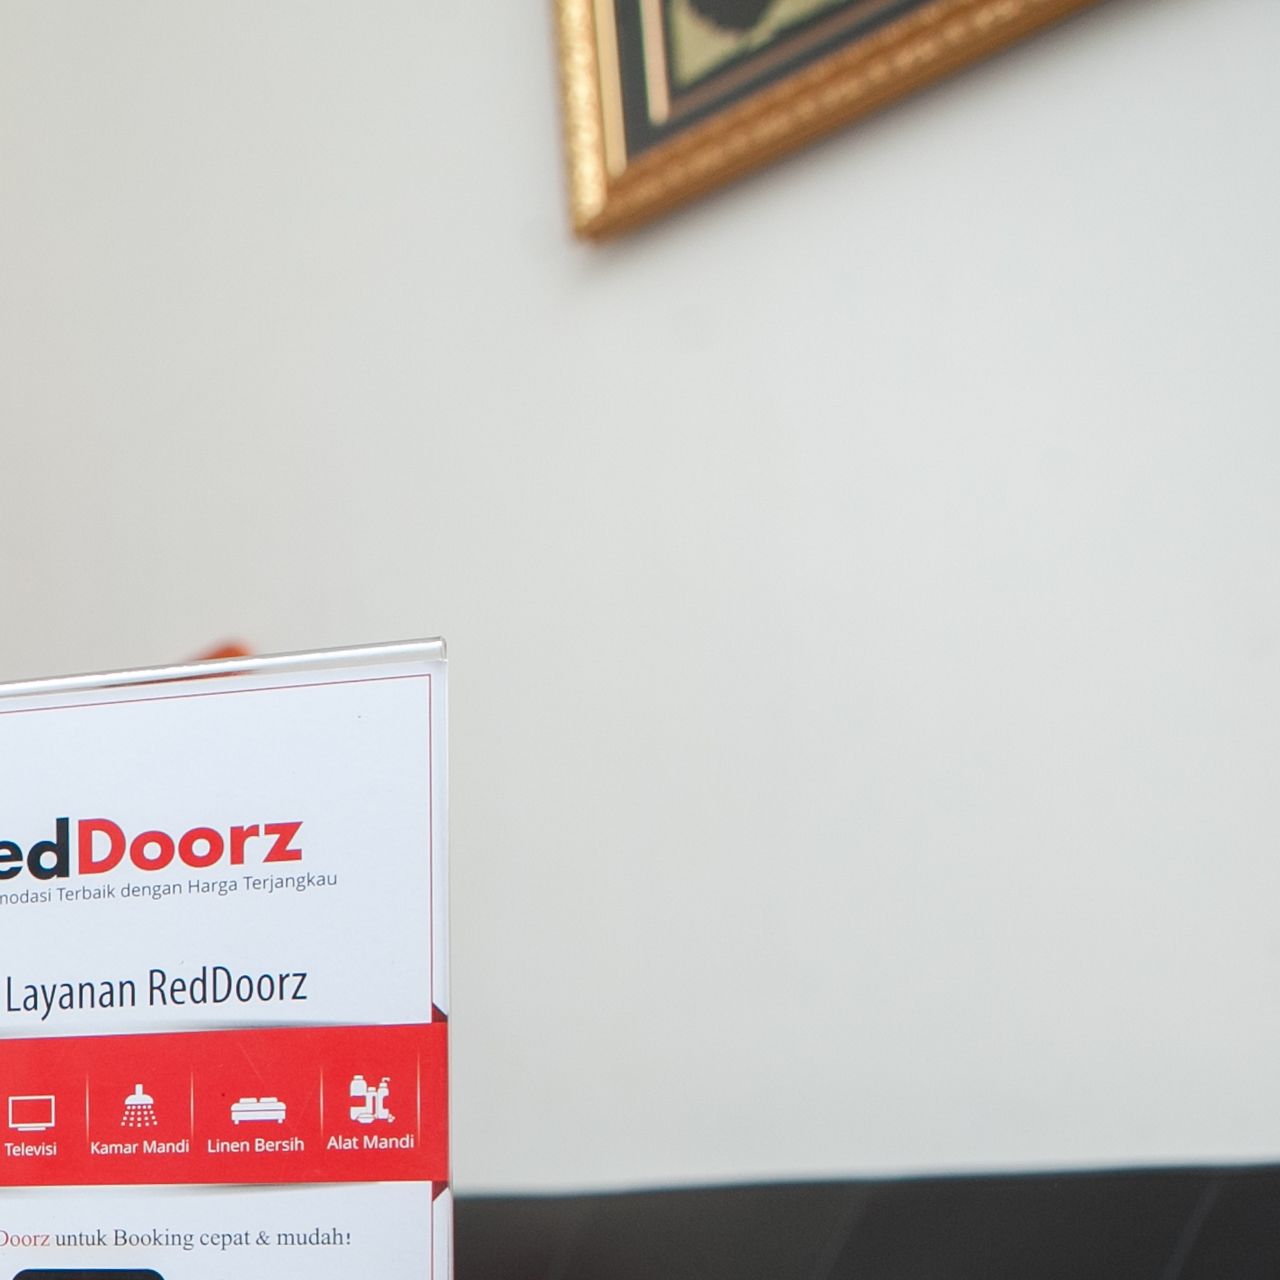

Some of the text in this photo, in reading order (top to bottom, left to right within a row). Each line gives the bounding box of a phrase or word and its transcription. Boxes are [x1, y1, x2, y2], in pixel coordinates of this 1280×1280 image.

[56, 883, 115, 903] Terbaik
[120, 880, 182, 900] dengan
[188, 877, 238, 898] Harga
[243, 871, 338, 893] Terjangkau
[6, 975, 136, 1021] Layanan
[148, 966, 308, 1007] RedDoorz
[4, 1142, 57, 1157] Televisi
[90, 1138, 190, 1155] Kamar Mandi
[207, 1136, 305, 1153] Linen Bersih
[326, 1134, 415, 1151] Alat Mandi
[55, 1229, 108, 1247] untuk
[113, 1228, 195, 1251] Booking
[199, 1230, 251, 1250] cepat
[255, 1231, 271, 1247] &
[276, 1228, 352, 1247] mudah!
